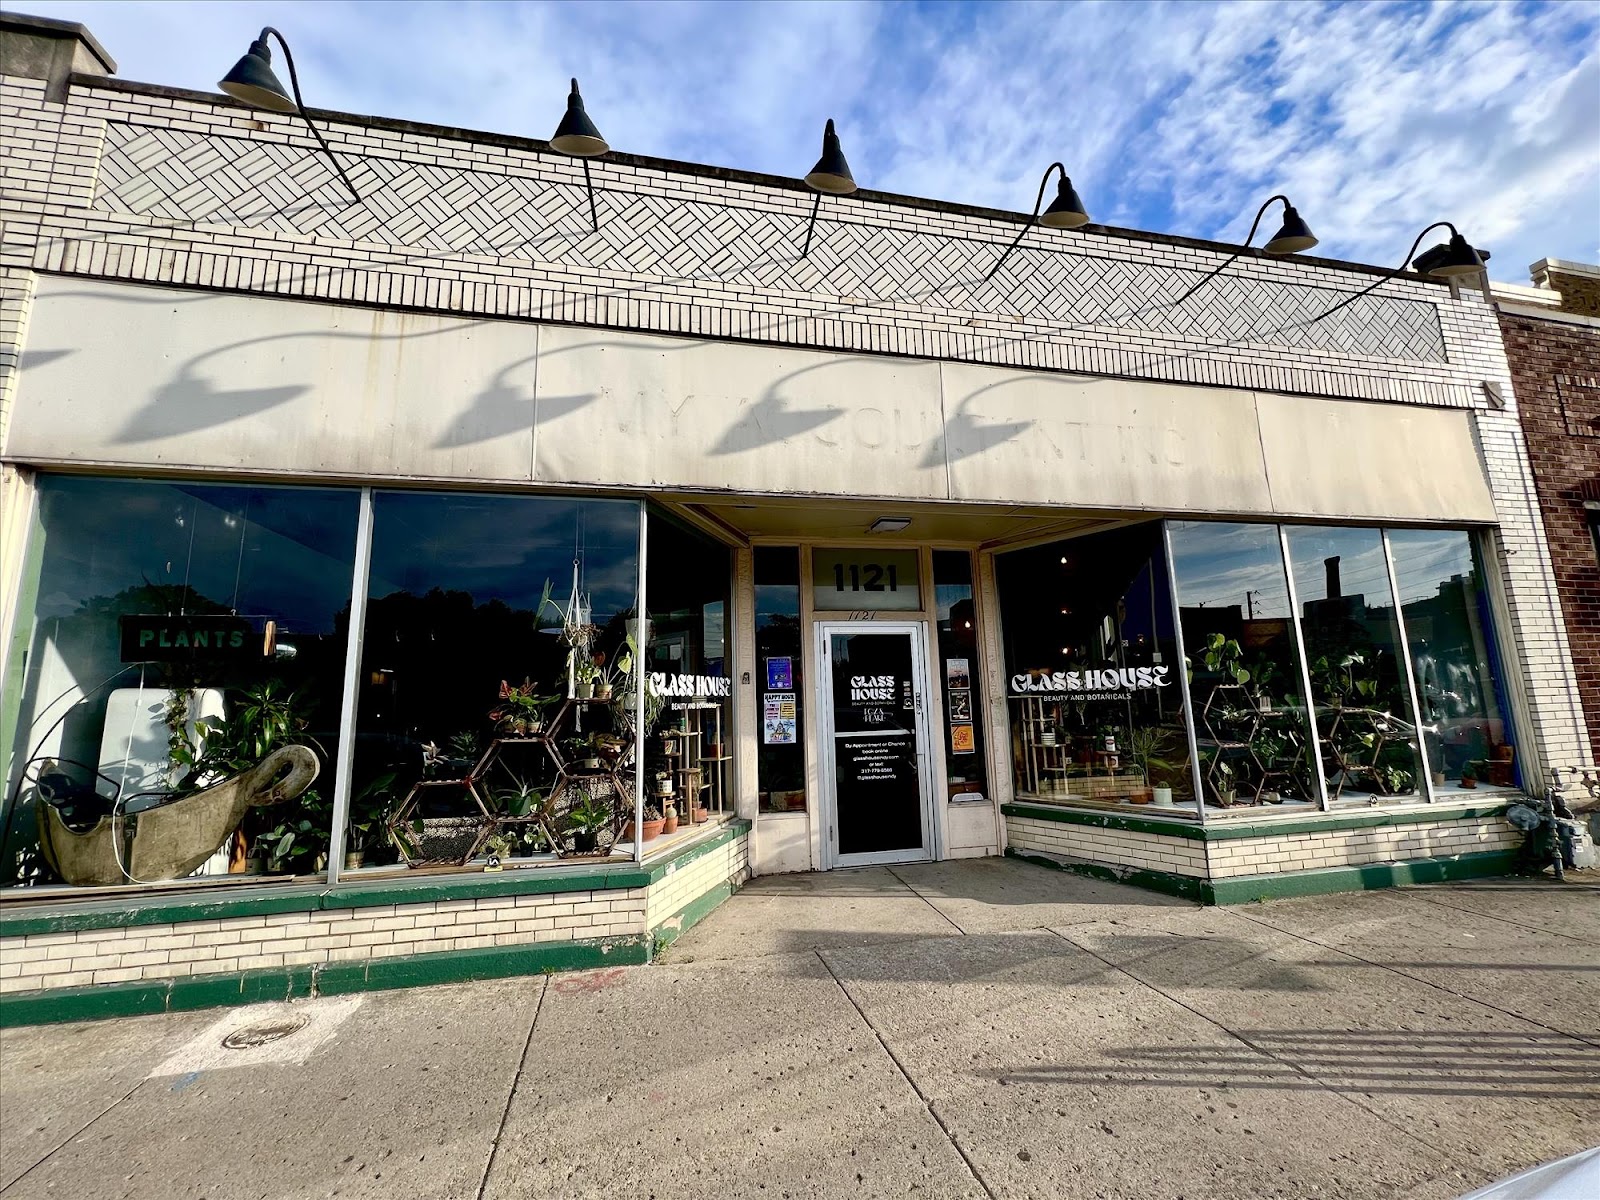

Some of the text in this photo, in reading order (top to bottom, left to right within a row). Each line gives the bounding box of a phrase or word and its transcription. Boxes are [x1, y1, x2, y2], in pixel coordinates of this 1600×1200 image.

[833, 563, 897, 592] 1121
[848, 610, 877, 621] 1121
[139, 629, 243, 648] PLANTS
[649, 672, 695, 697] GLASS
[696, 675, 731, 697] HOUSE
[851, 675, 895, 688] GLASS
[1011, 665, 1172, 693] GLASS HOUSE
[764, 694, 780, 702] HAPPY
[851, 688, 896, 700] HOUSE
[1043, 694, 1069, 702] BEAUTY
[1087, 692, 1132, 701] BOTANICALS
